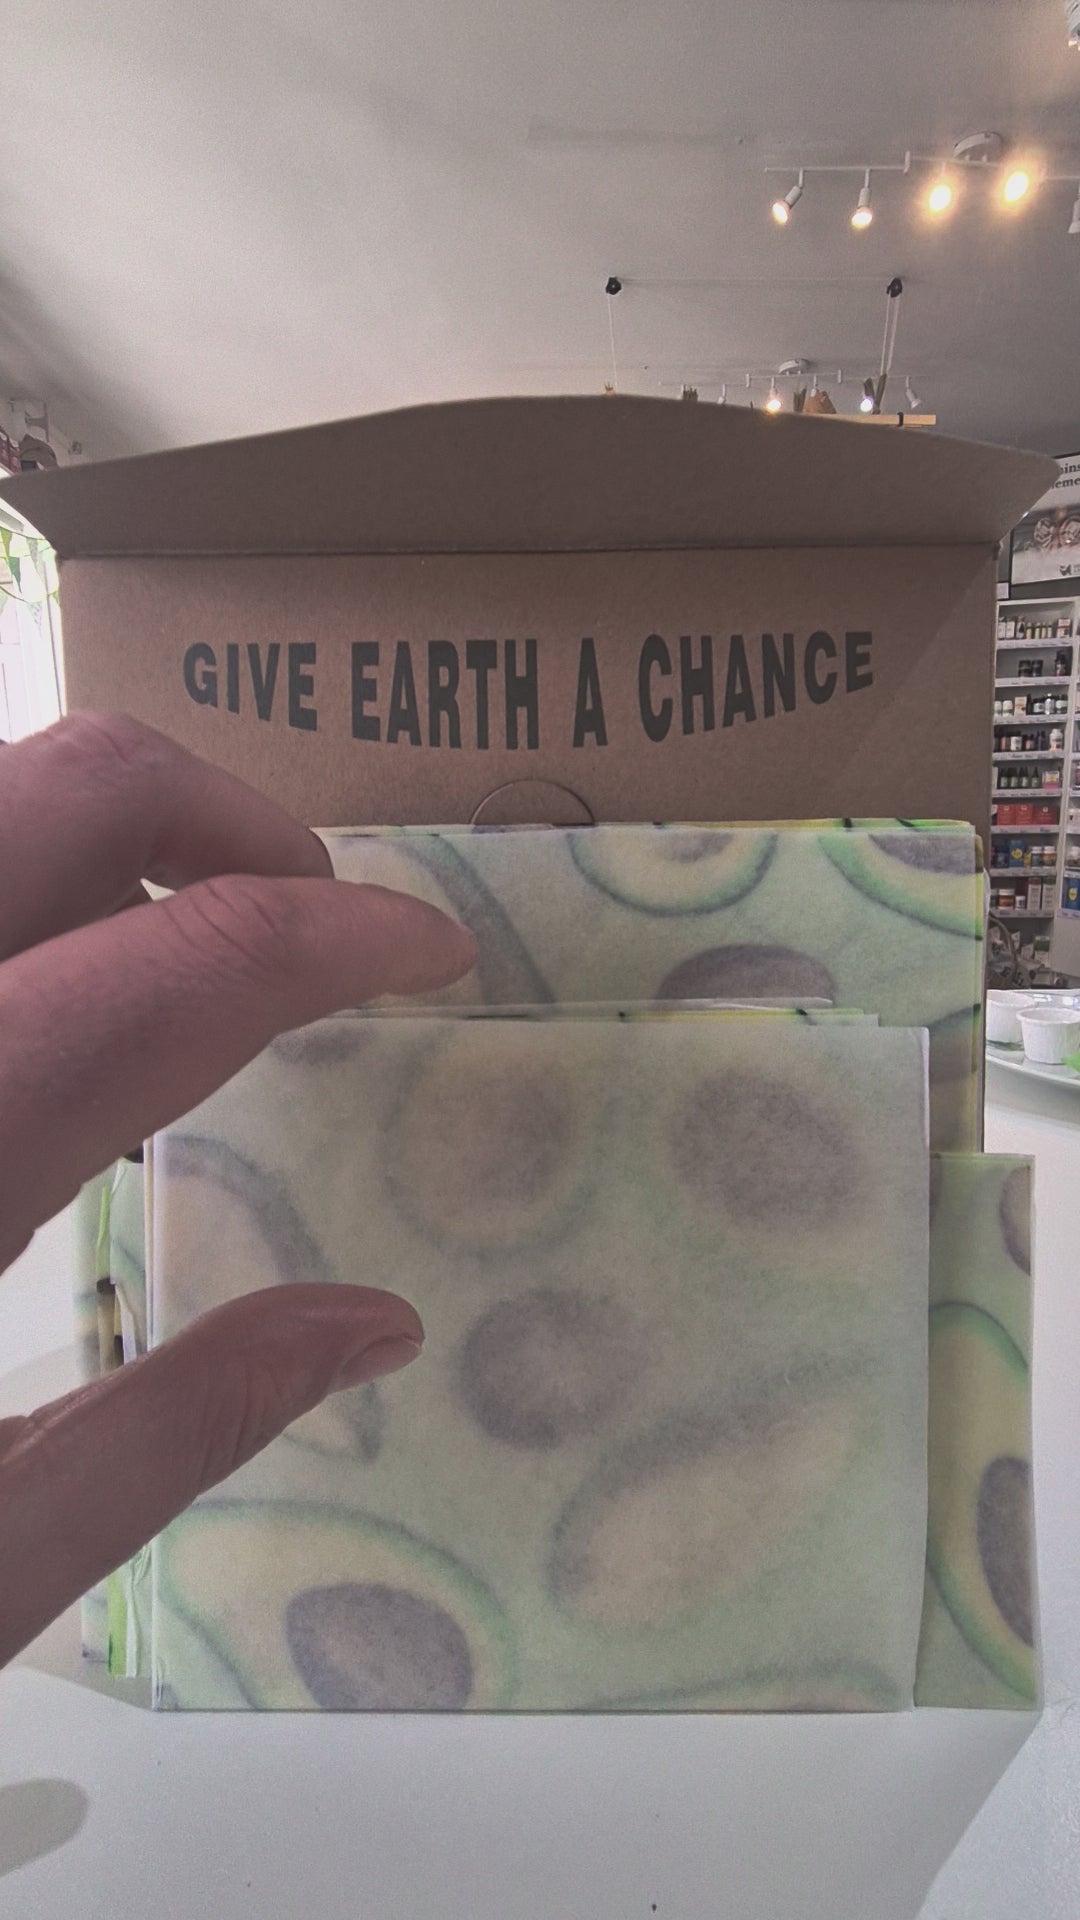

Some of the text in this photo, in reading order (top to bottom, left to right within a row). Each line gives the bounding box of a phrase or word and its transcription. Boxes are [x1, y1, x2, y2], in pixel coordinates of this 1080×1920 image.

[183, 630, 873, 750] GIVE EARTH A CHANCE
